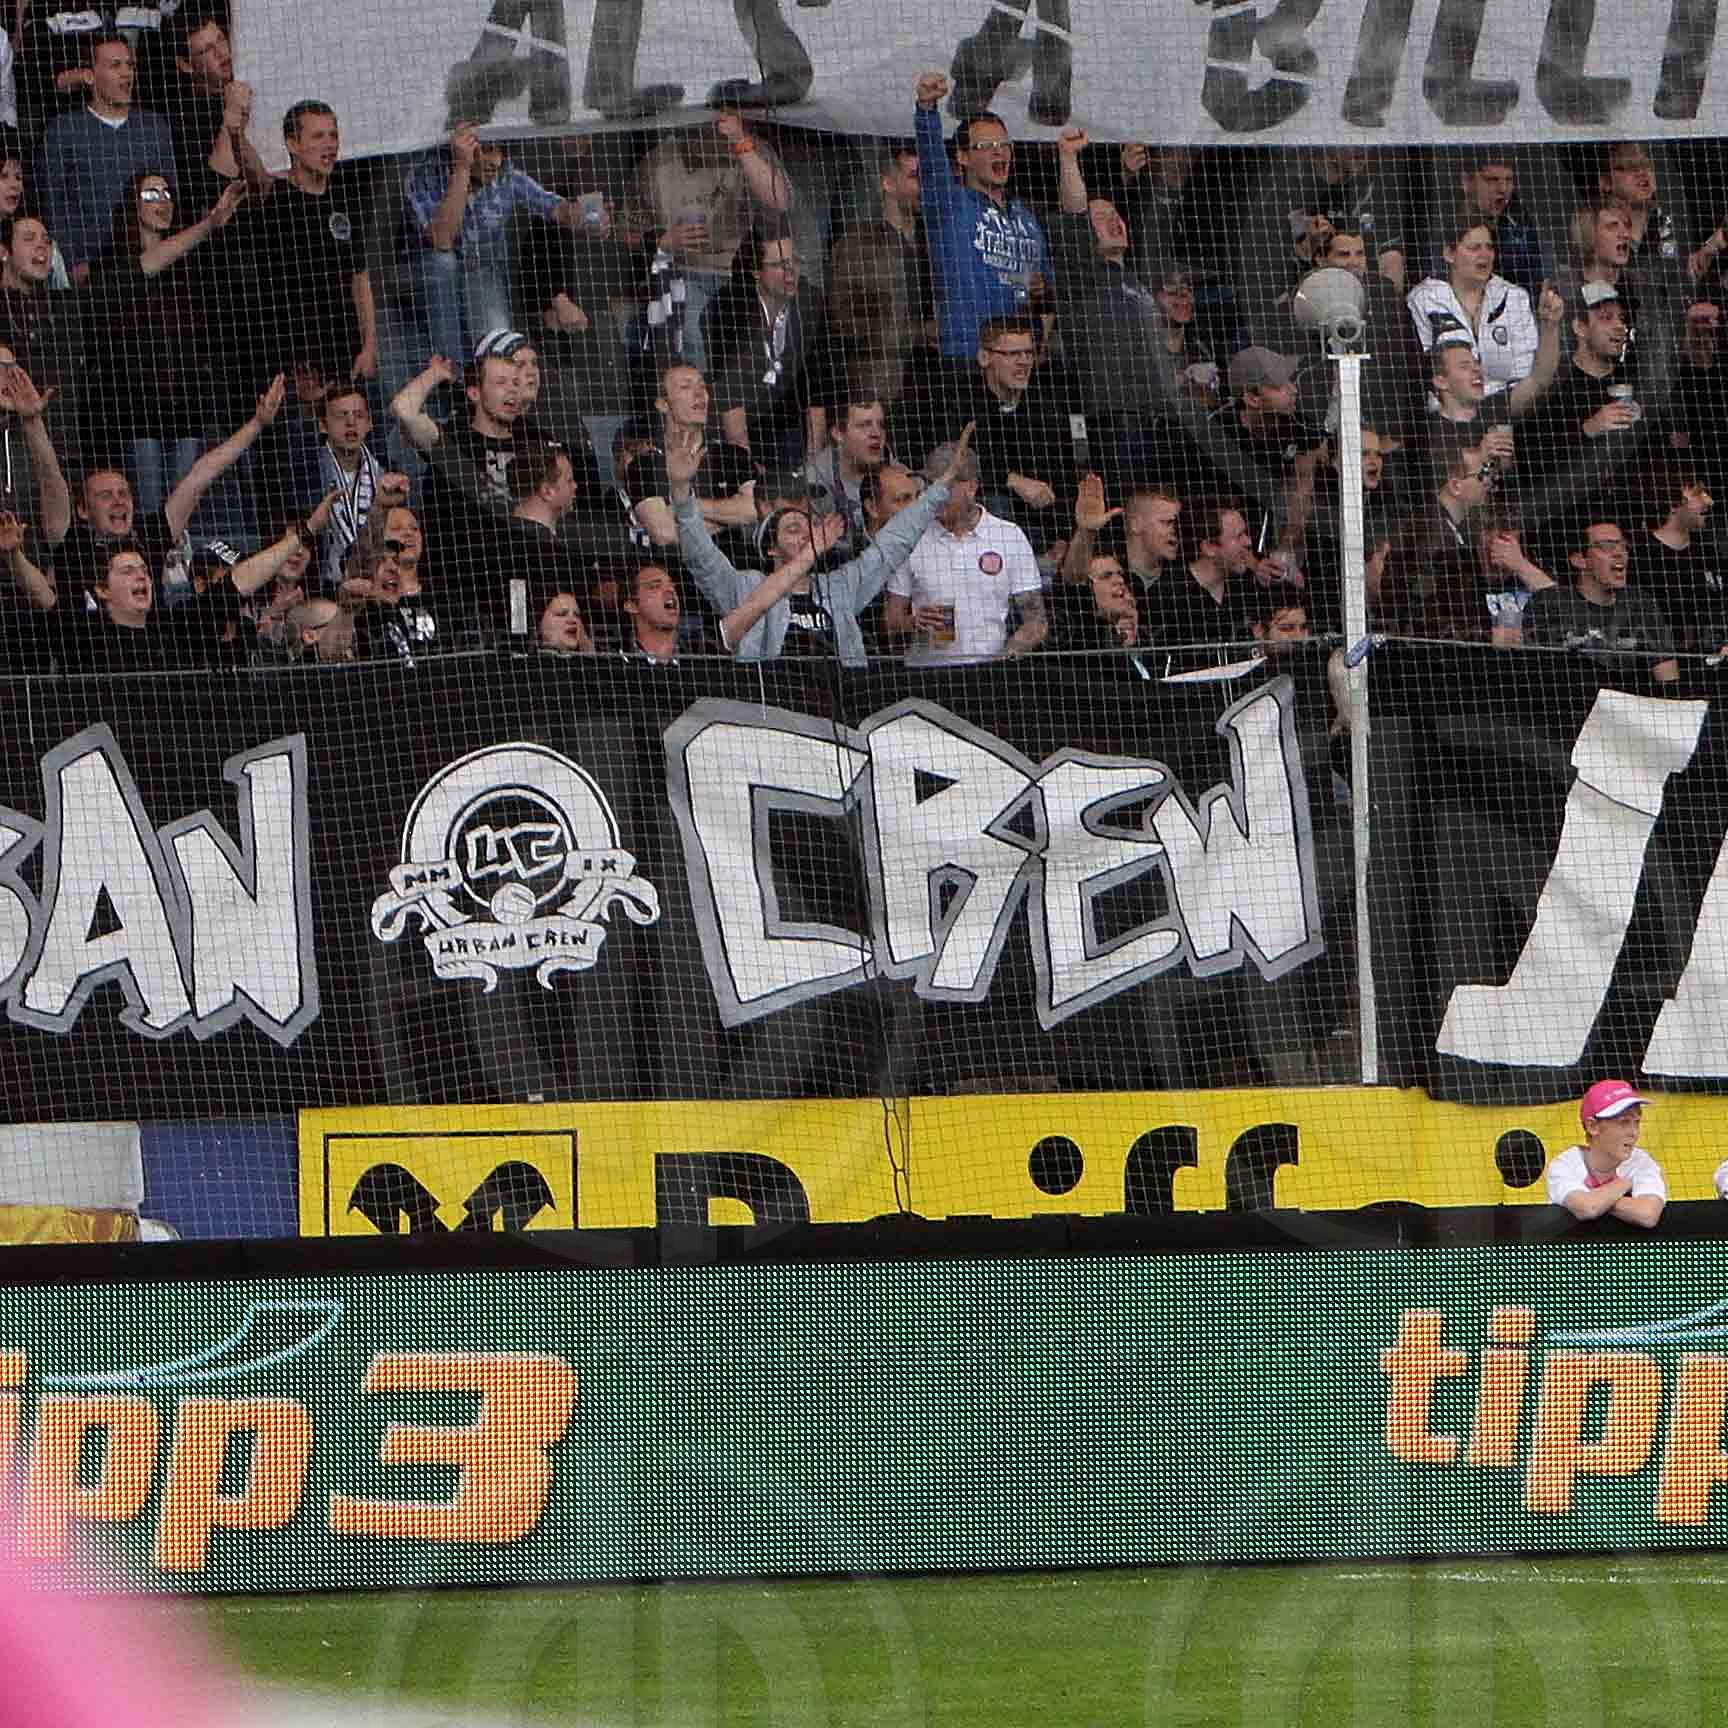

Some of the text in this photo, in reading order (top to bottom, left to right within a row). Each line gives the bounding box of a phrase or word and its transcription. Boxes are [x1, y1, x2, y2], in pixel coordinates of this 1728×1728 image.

[0, 722, 320, 1048] AN
[438, 928, 589, 955] URBAN CREW
[663, 674, 1326, 1030] CREW
